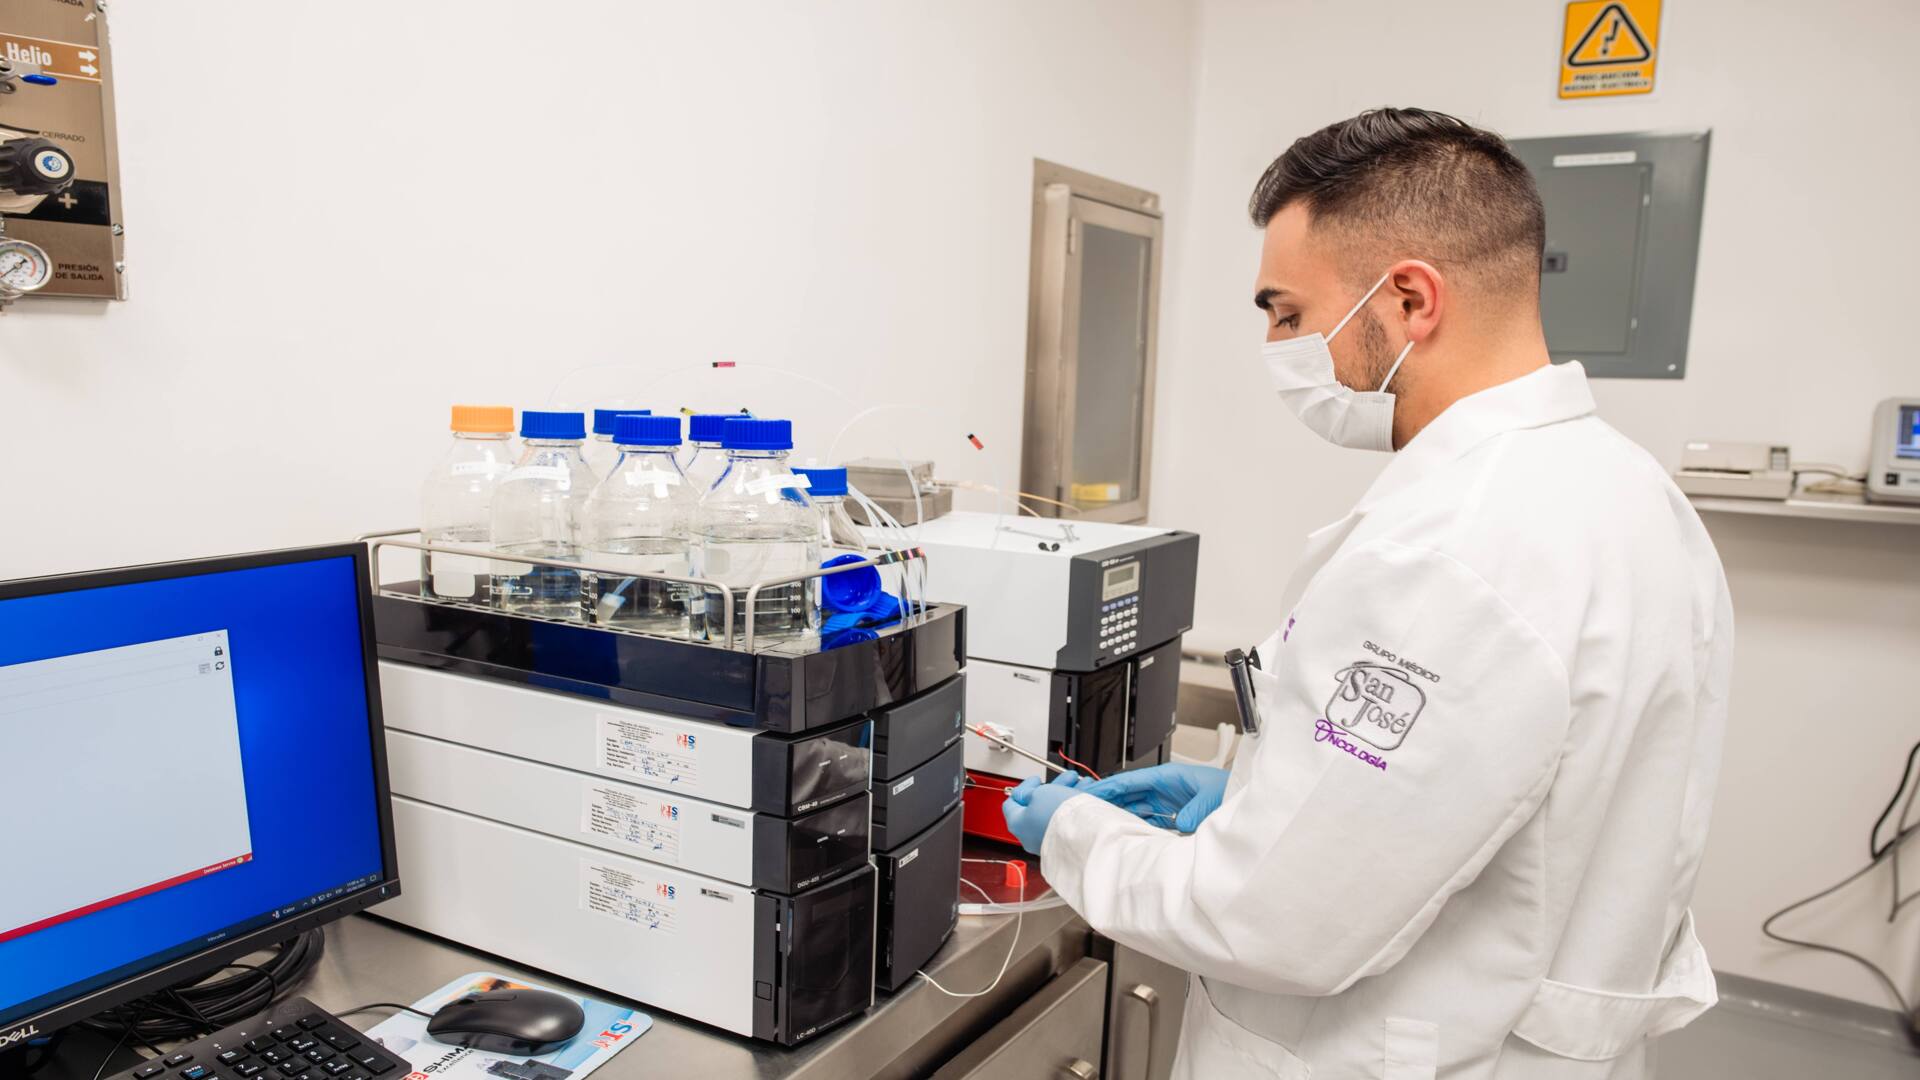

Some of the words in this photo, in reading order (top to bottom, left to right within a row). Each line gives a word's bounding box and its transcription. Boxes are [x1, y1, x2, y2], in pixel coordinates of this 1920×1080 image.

[6, 42, 52, 66] Helio
[42, 131, 85, 143] CERRADO
[58, 263, 99, 272] PRESIÓN
[71, 273, 104, 281] SALIDA
[1362, 640, 1397, 662] GRUPO
[1397, 657, 1441, 683] MÉDICO
[1341, 668, 1395, 704] San
[1340, 694, 1410, 735] José
[0, 1025, 40, 1048] DELL
